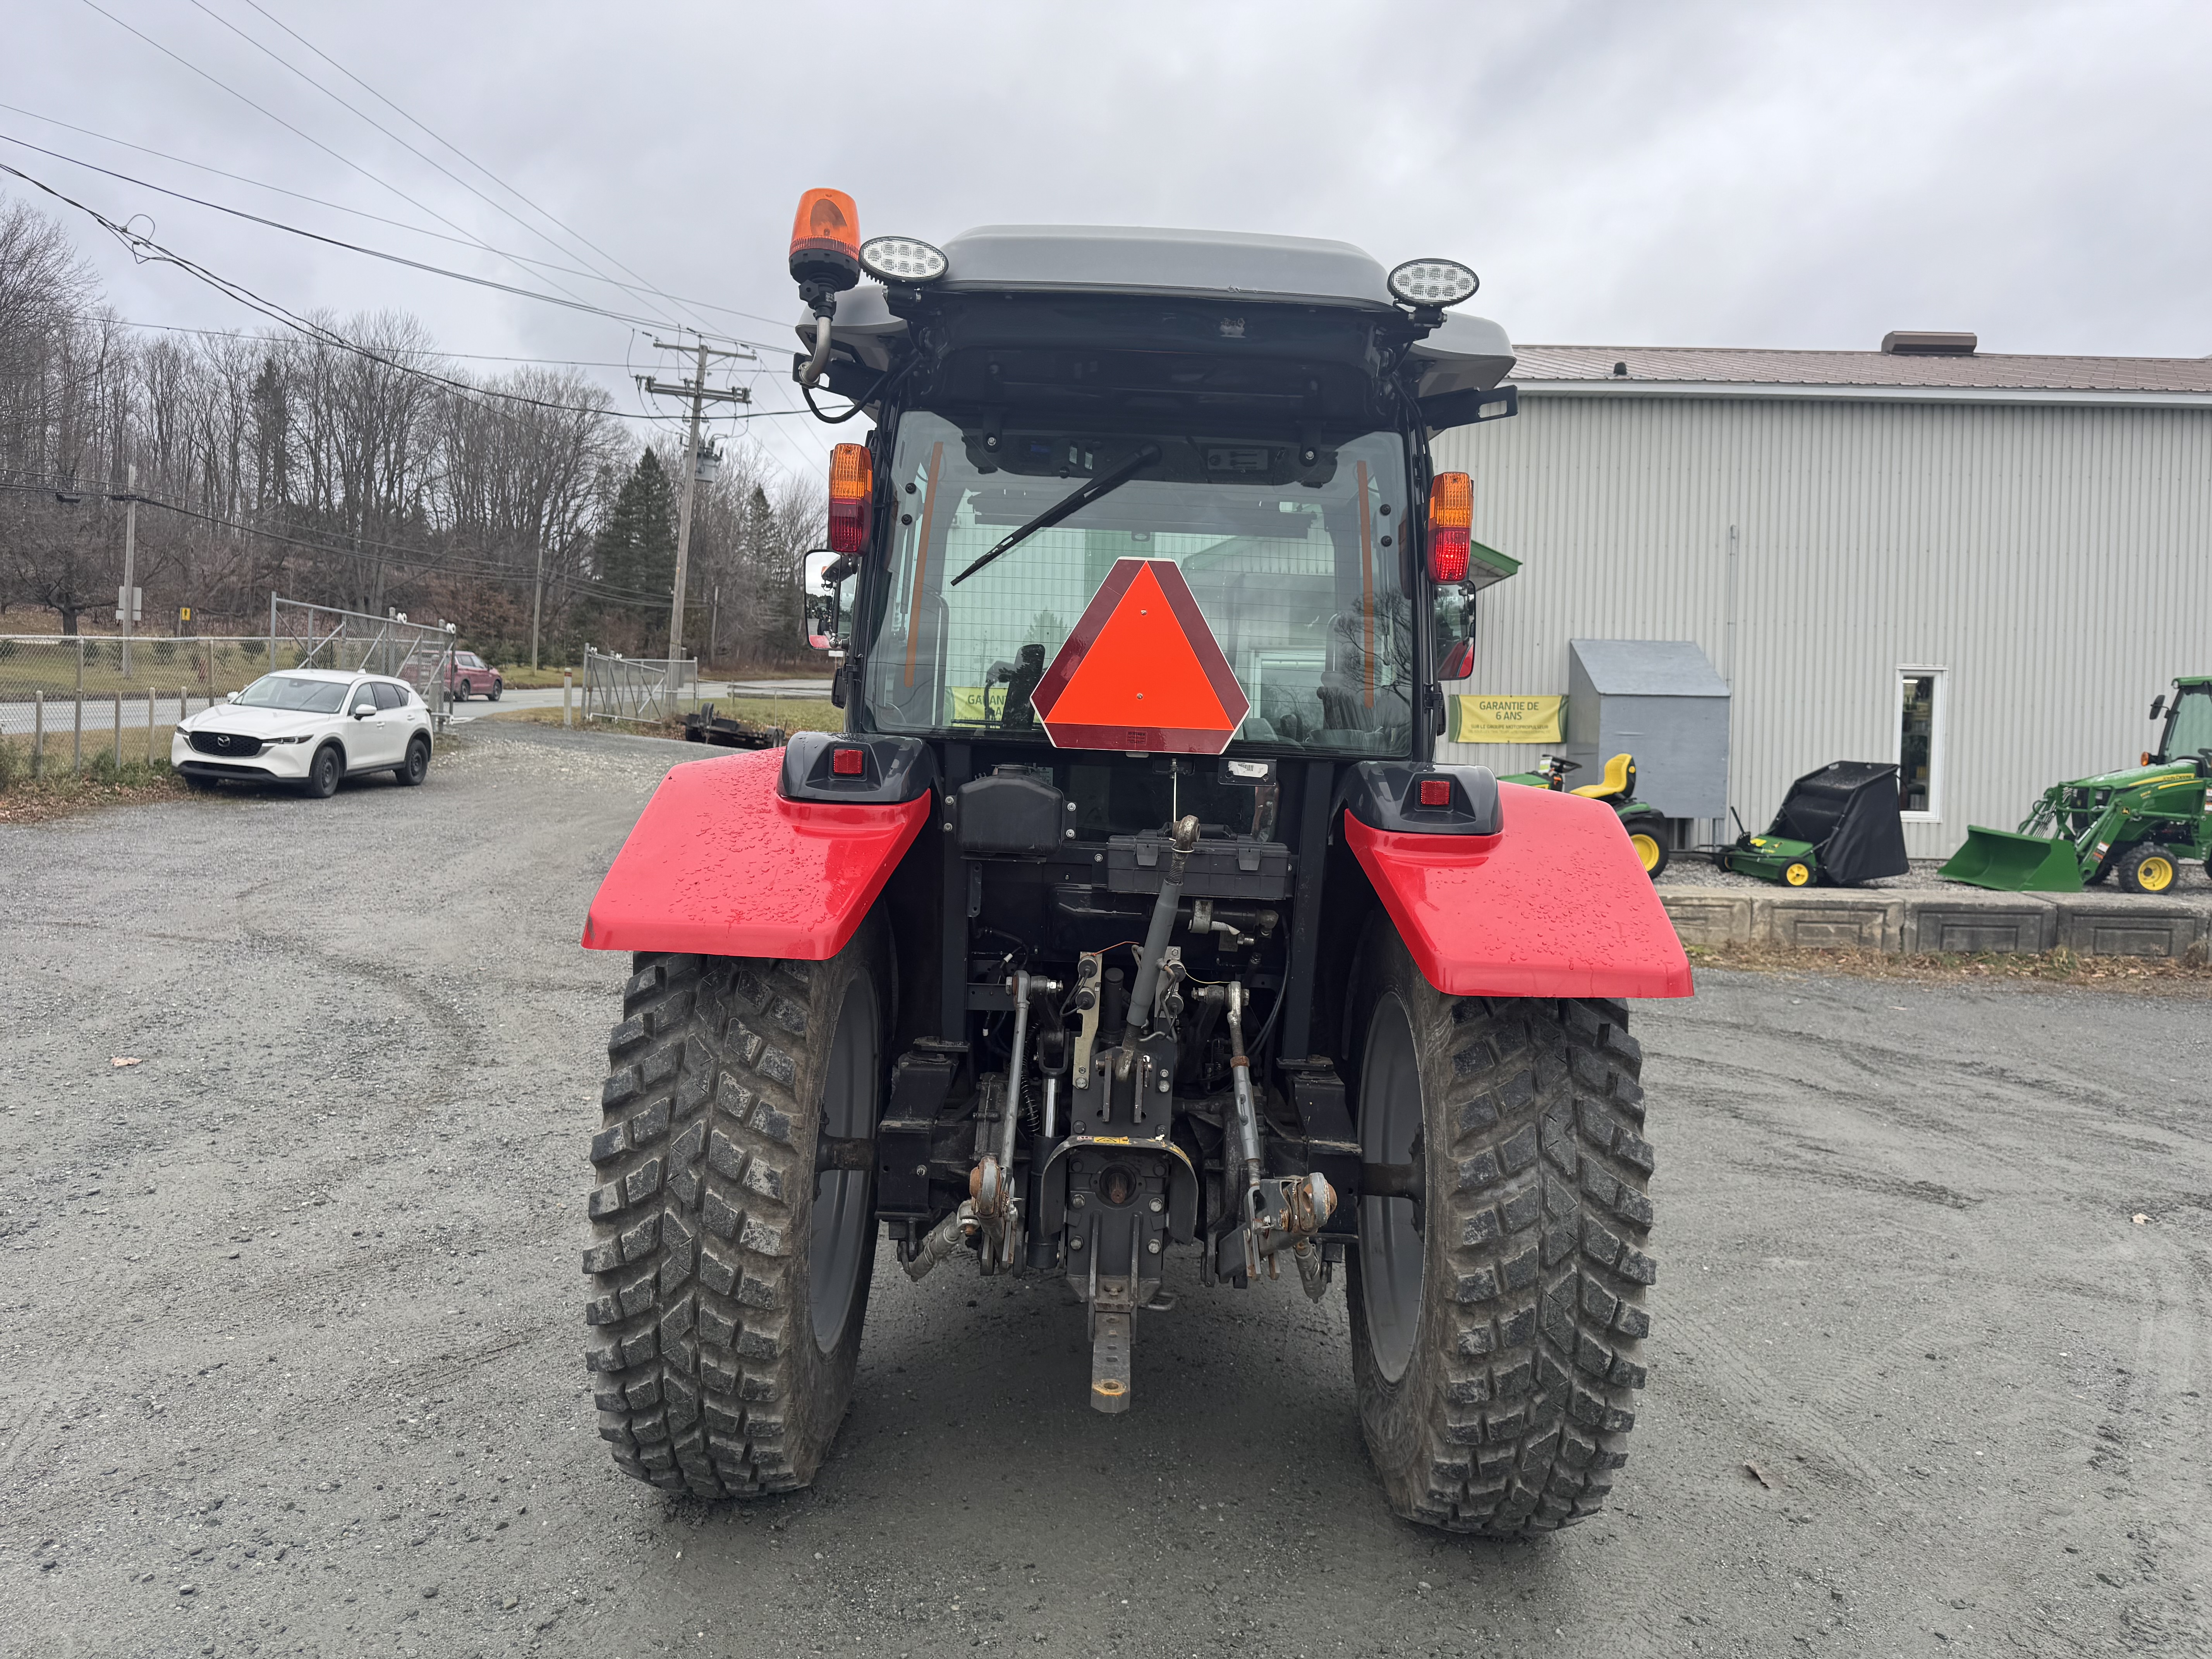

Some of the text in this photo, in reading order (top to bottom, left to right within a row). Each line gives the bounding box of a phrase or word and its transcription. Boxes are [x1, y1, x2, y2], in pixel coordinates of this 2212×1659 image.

[1479, 701, 1539, 711] GARANTIE DE
[1496, 711, 1522, 720] 6 ANS
